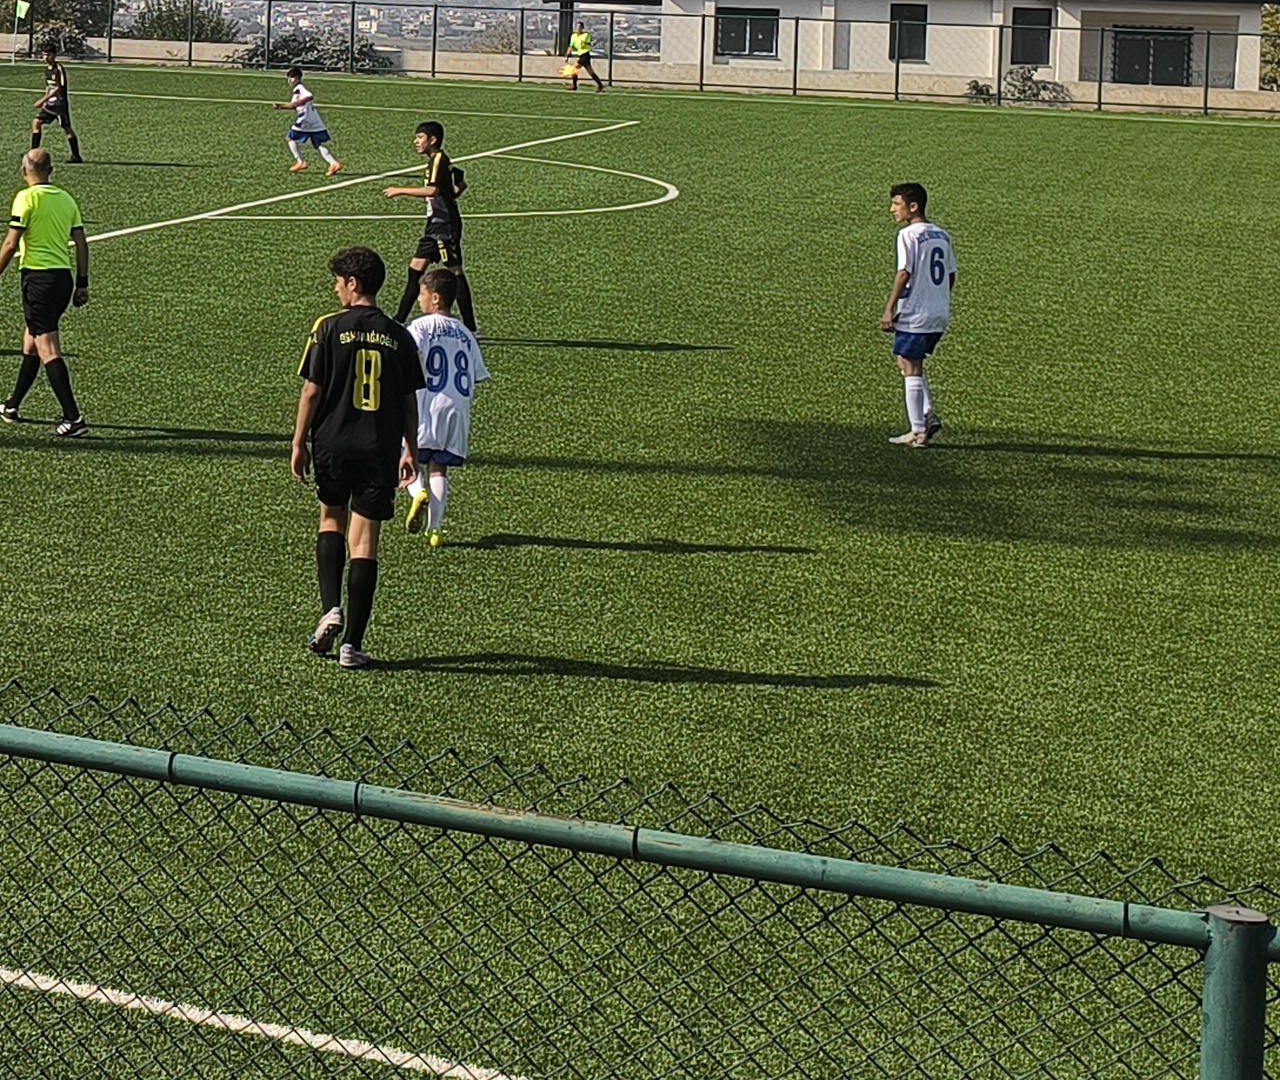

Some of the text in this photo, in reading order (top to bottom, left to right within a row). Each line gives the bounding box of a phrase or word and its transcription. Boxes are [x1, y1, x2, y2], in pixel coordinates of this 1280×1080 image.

[930, 246, 945, 286] 6
[353, 348, 381, 412] 8
[426, 345, 471, 397] 98
